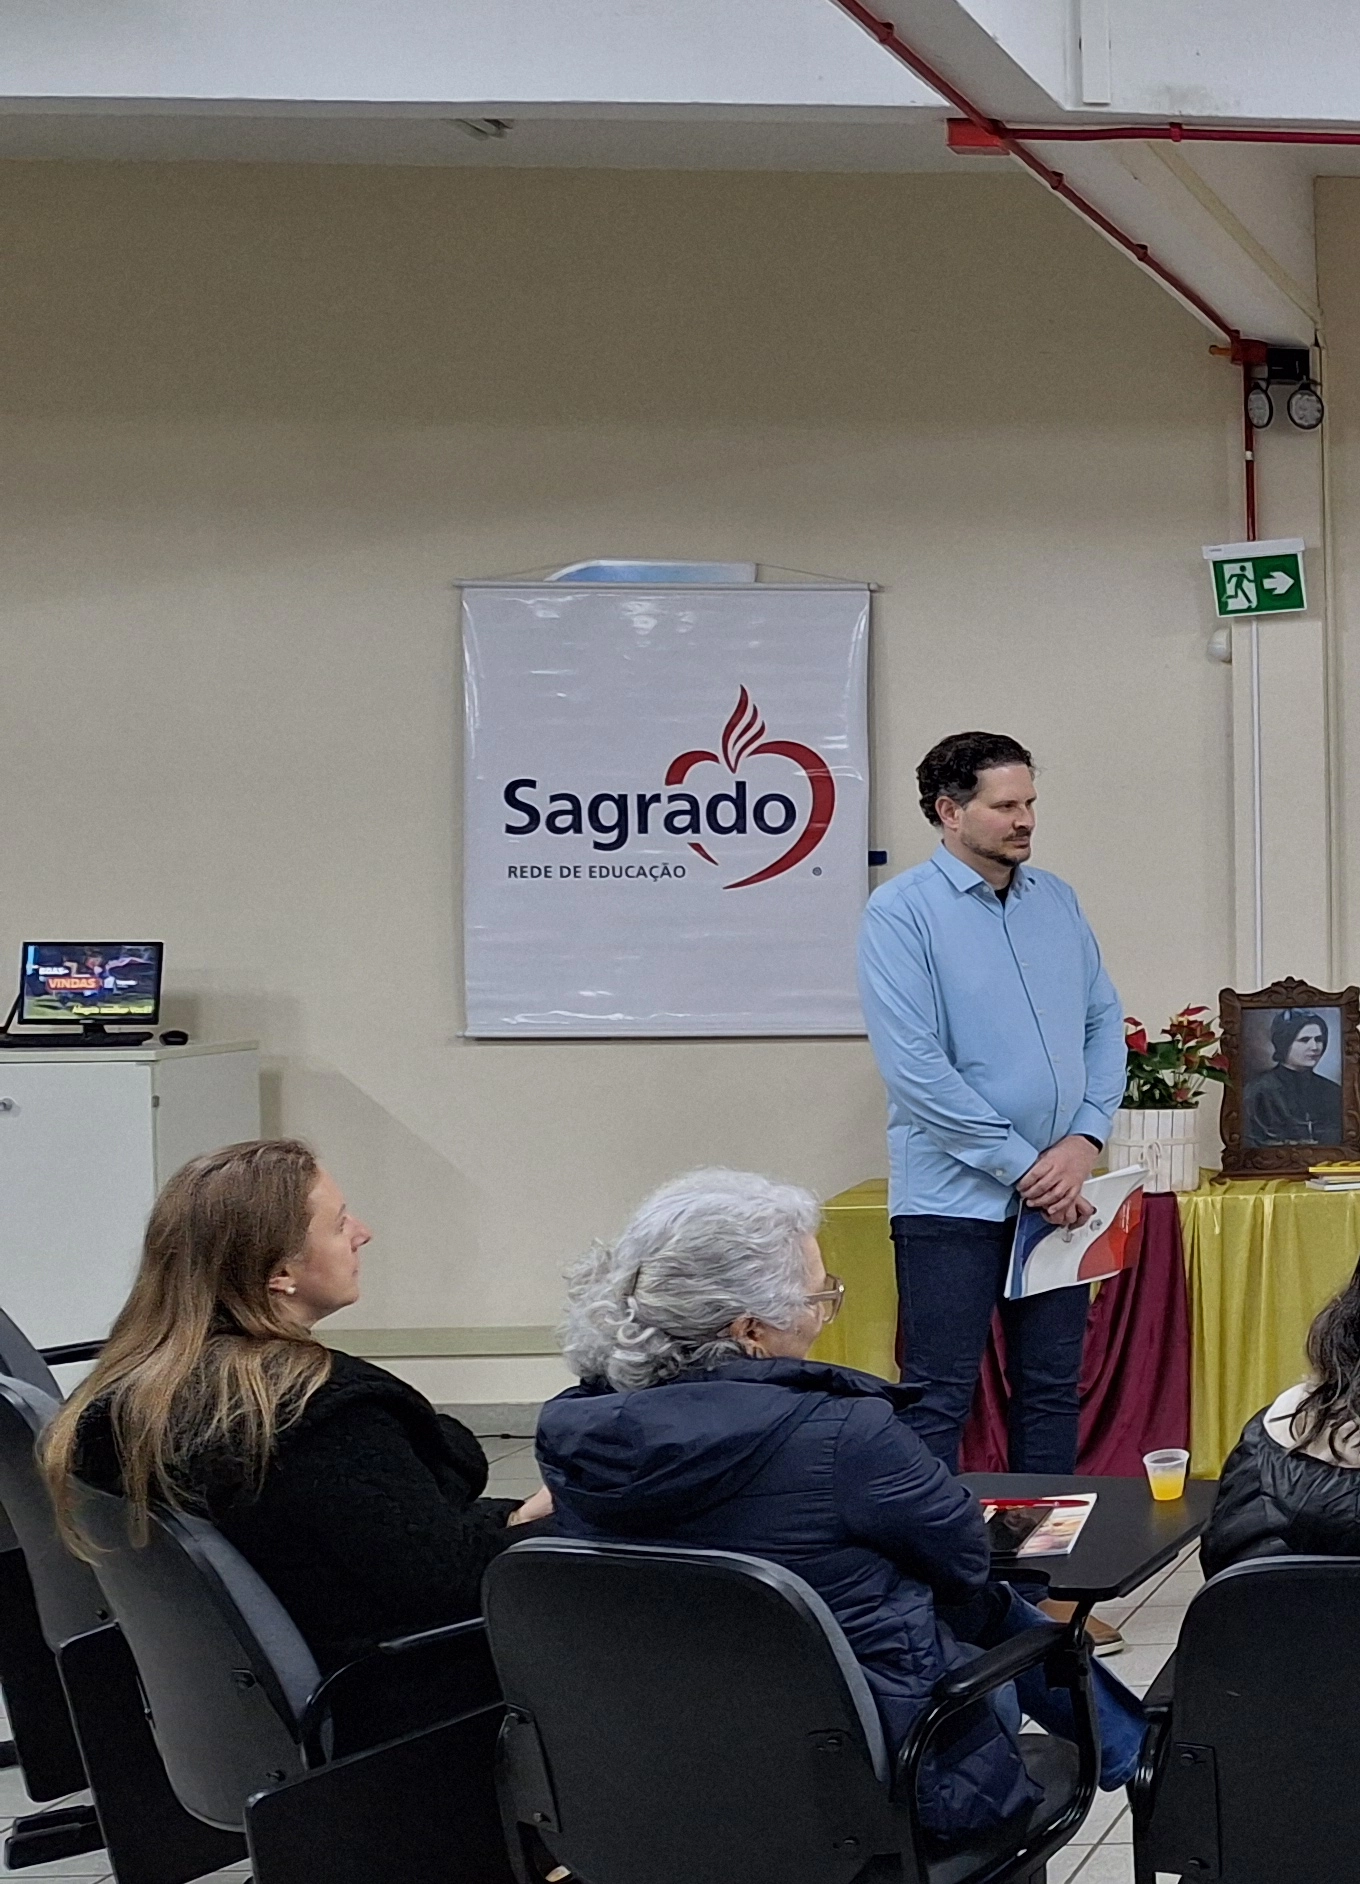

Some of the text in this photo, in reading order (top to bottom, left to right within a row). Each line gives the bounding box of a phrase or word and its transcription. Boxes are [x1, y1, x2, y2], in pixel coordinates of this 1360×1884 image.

[503, 778, 797, 851] Sagrado
[507, 862, 687, 883] REDE DE EDUCAÇÃO
[48, 978, 97, 989] VINDAS
